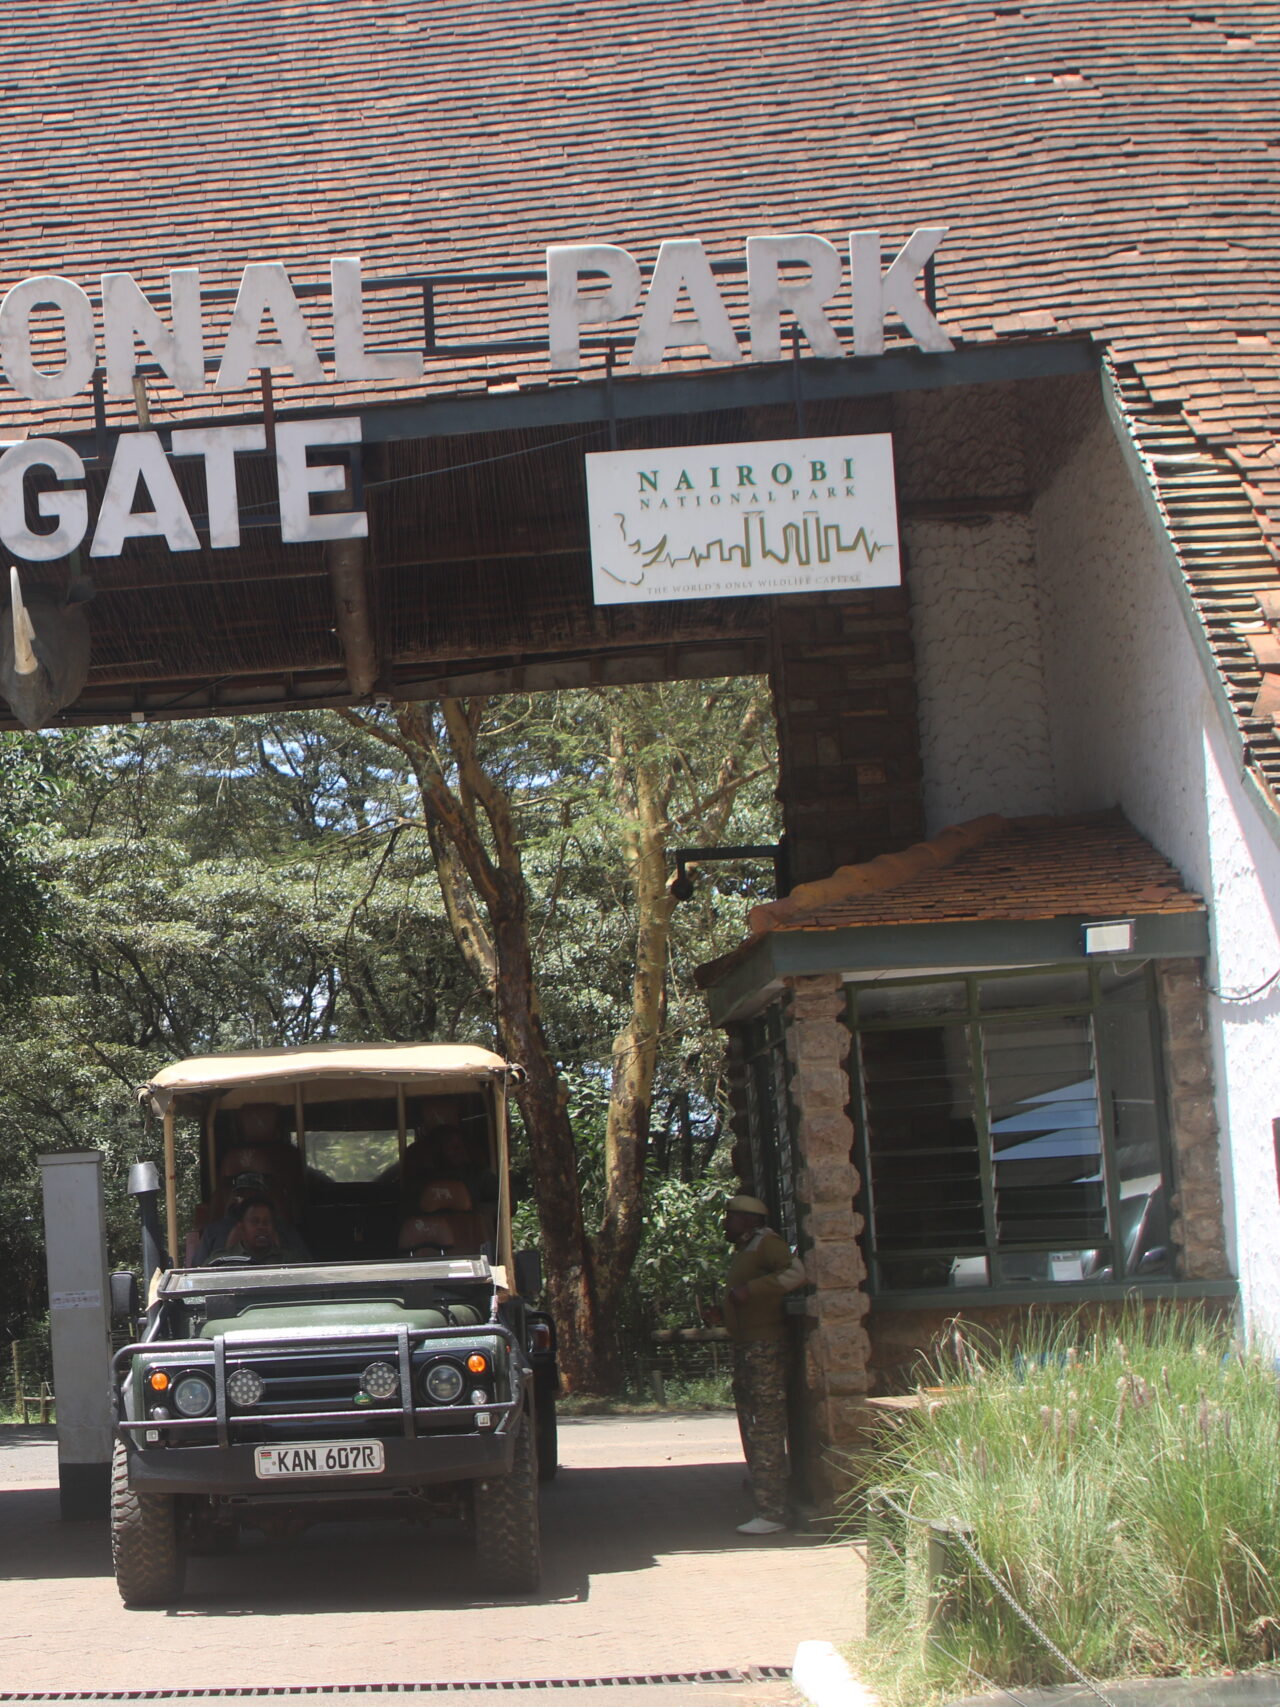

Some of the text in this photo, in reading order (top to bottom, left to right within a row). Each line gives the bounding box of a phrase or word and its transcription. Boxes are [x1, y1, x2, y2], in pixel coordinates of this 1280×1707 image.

[546, 226, 956, 371] PARK
[637, 457, 854, 492] NAIROBI
[640, 485, 855, 511] NATIONAL PARK
[647, 573, 862, 596] THE WORLD'S ONLY WILDLIFE CAPITAL
[277, 1446, 375, 1472] KAN 607R
